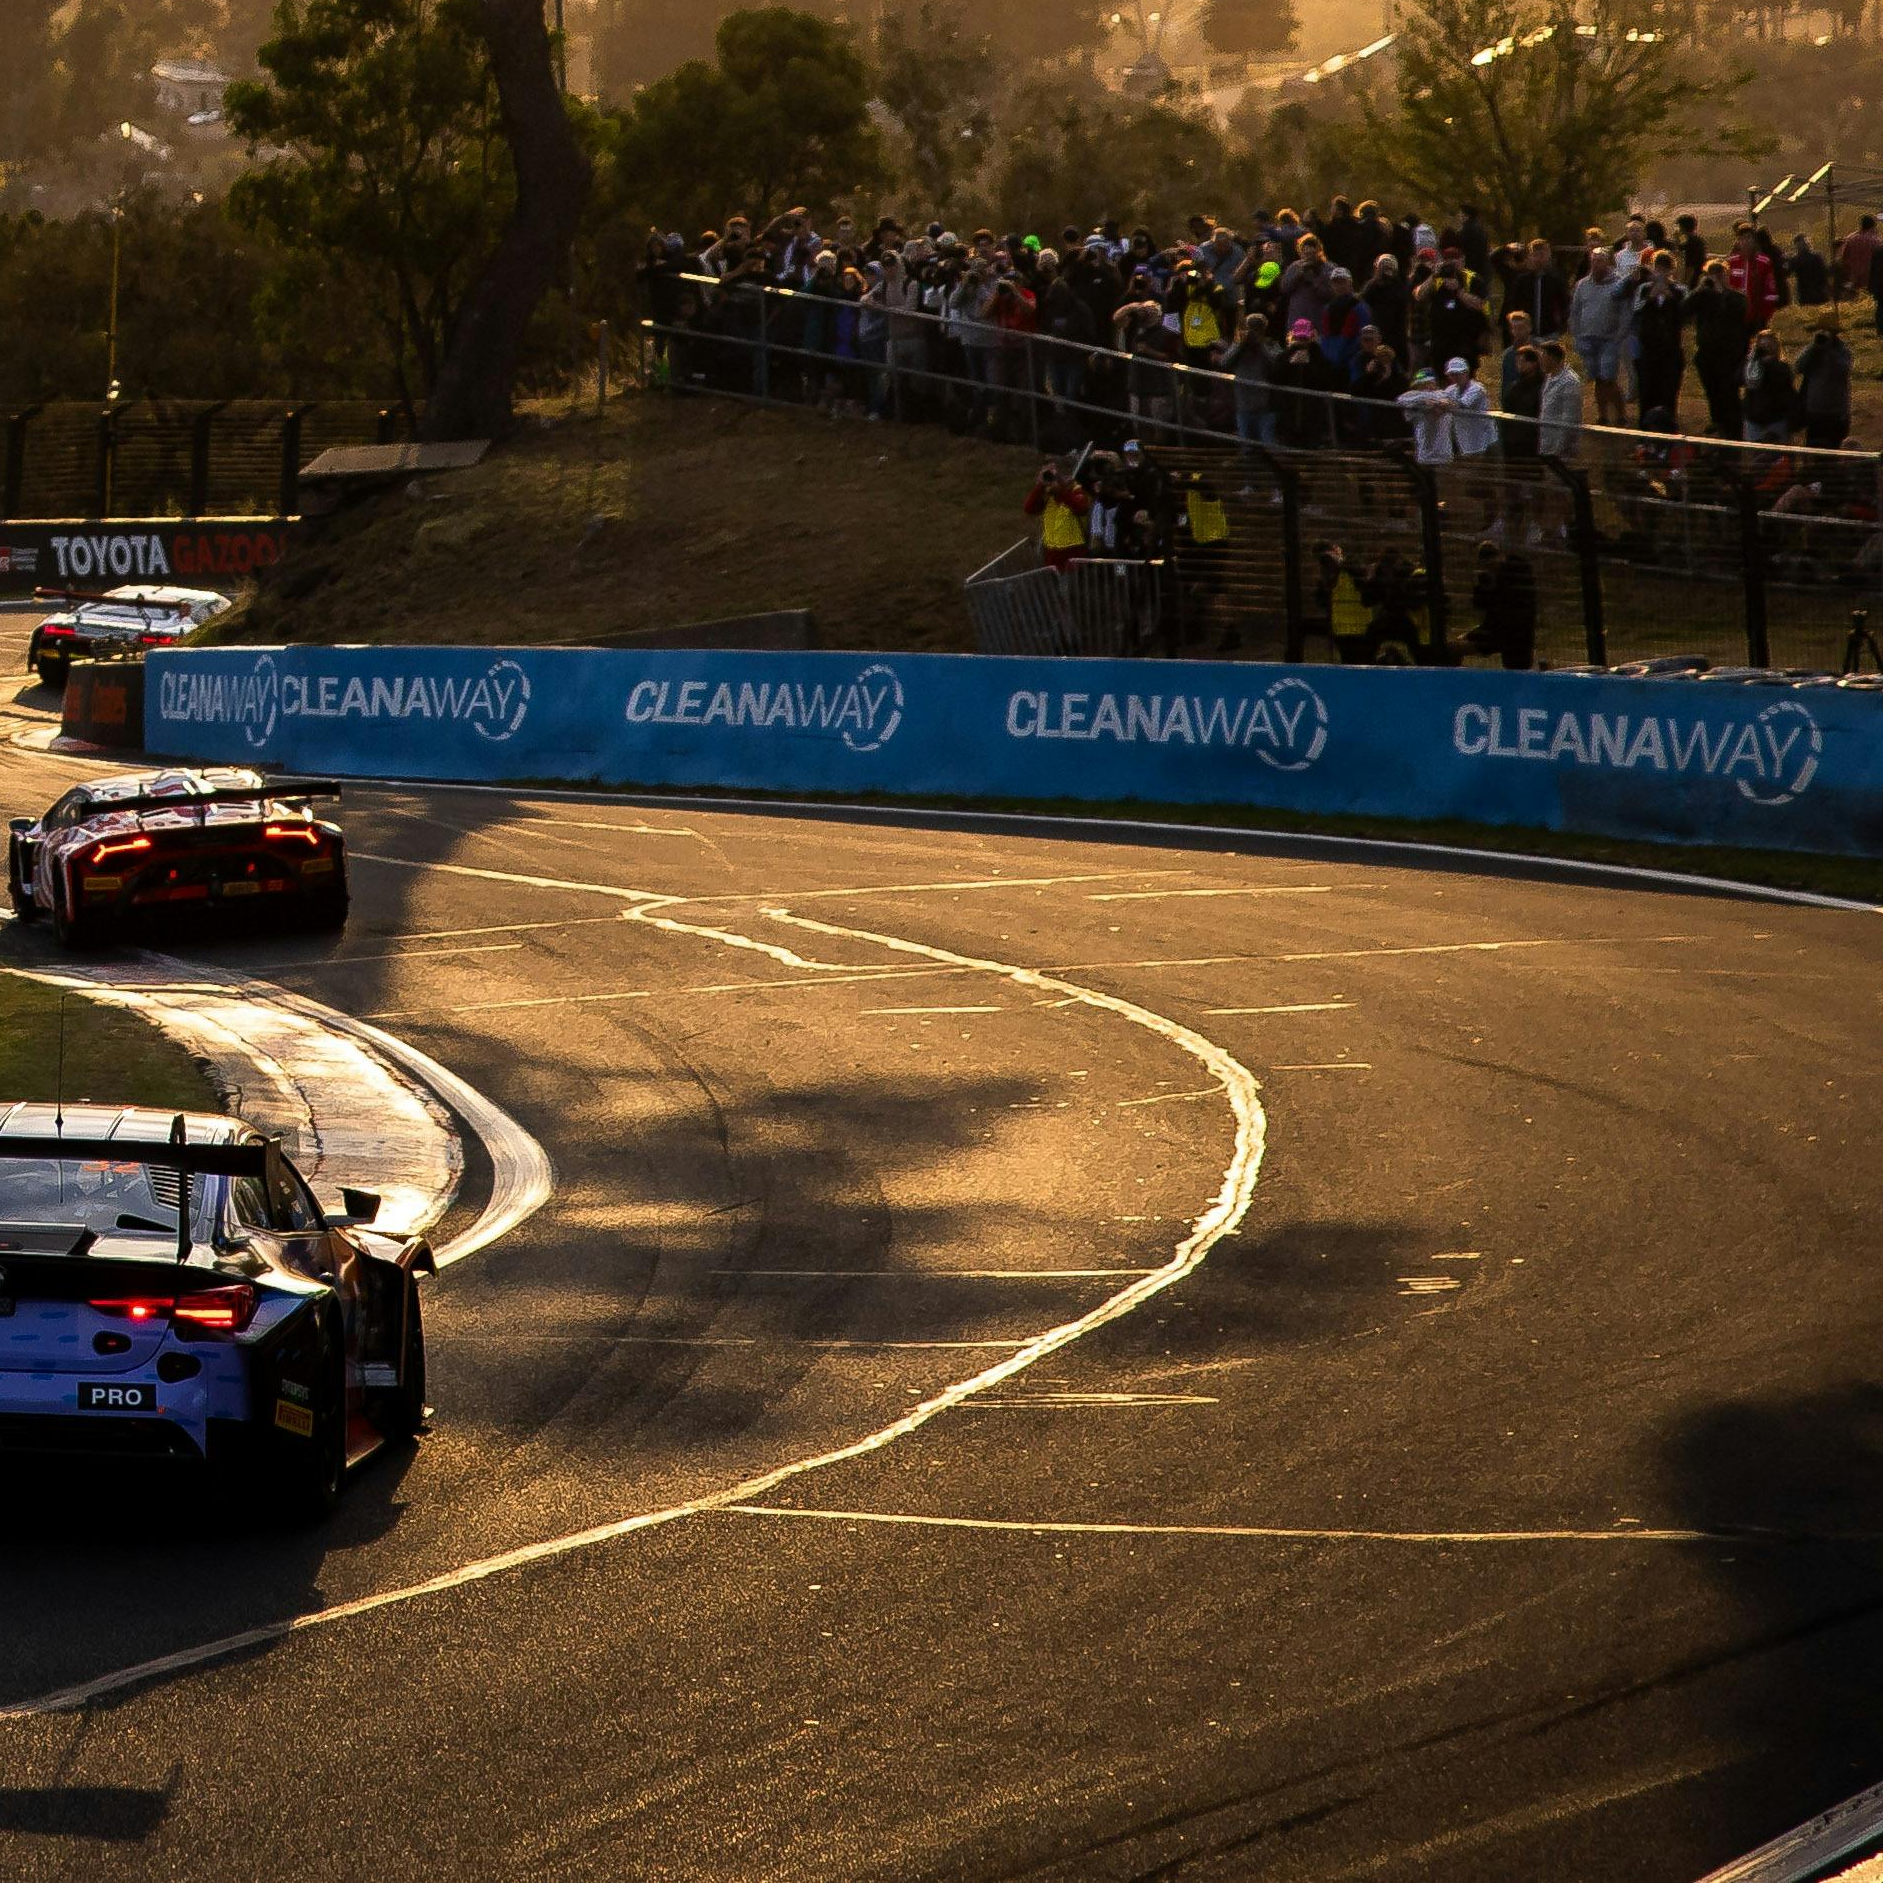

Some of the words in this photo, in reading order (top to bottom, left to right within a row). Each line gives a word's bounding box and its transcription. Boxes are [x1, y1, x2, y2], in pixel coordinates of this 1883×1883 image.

[51, 535, 170, 576] TOYOTA
[160, 671, 271, 723] CLEANAWAY
[281, 674, 517, 719] CLEANAWAY
[626, 680, 887, 729] CLEANAWAY
[1005, 690, 1307, 748] CLEANAWAY
[1453, 703, 1803, 779] CLEANAWAY
[91, 1388, 143, 1405] PRO
